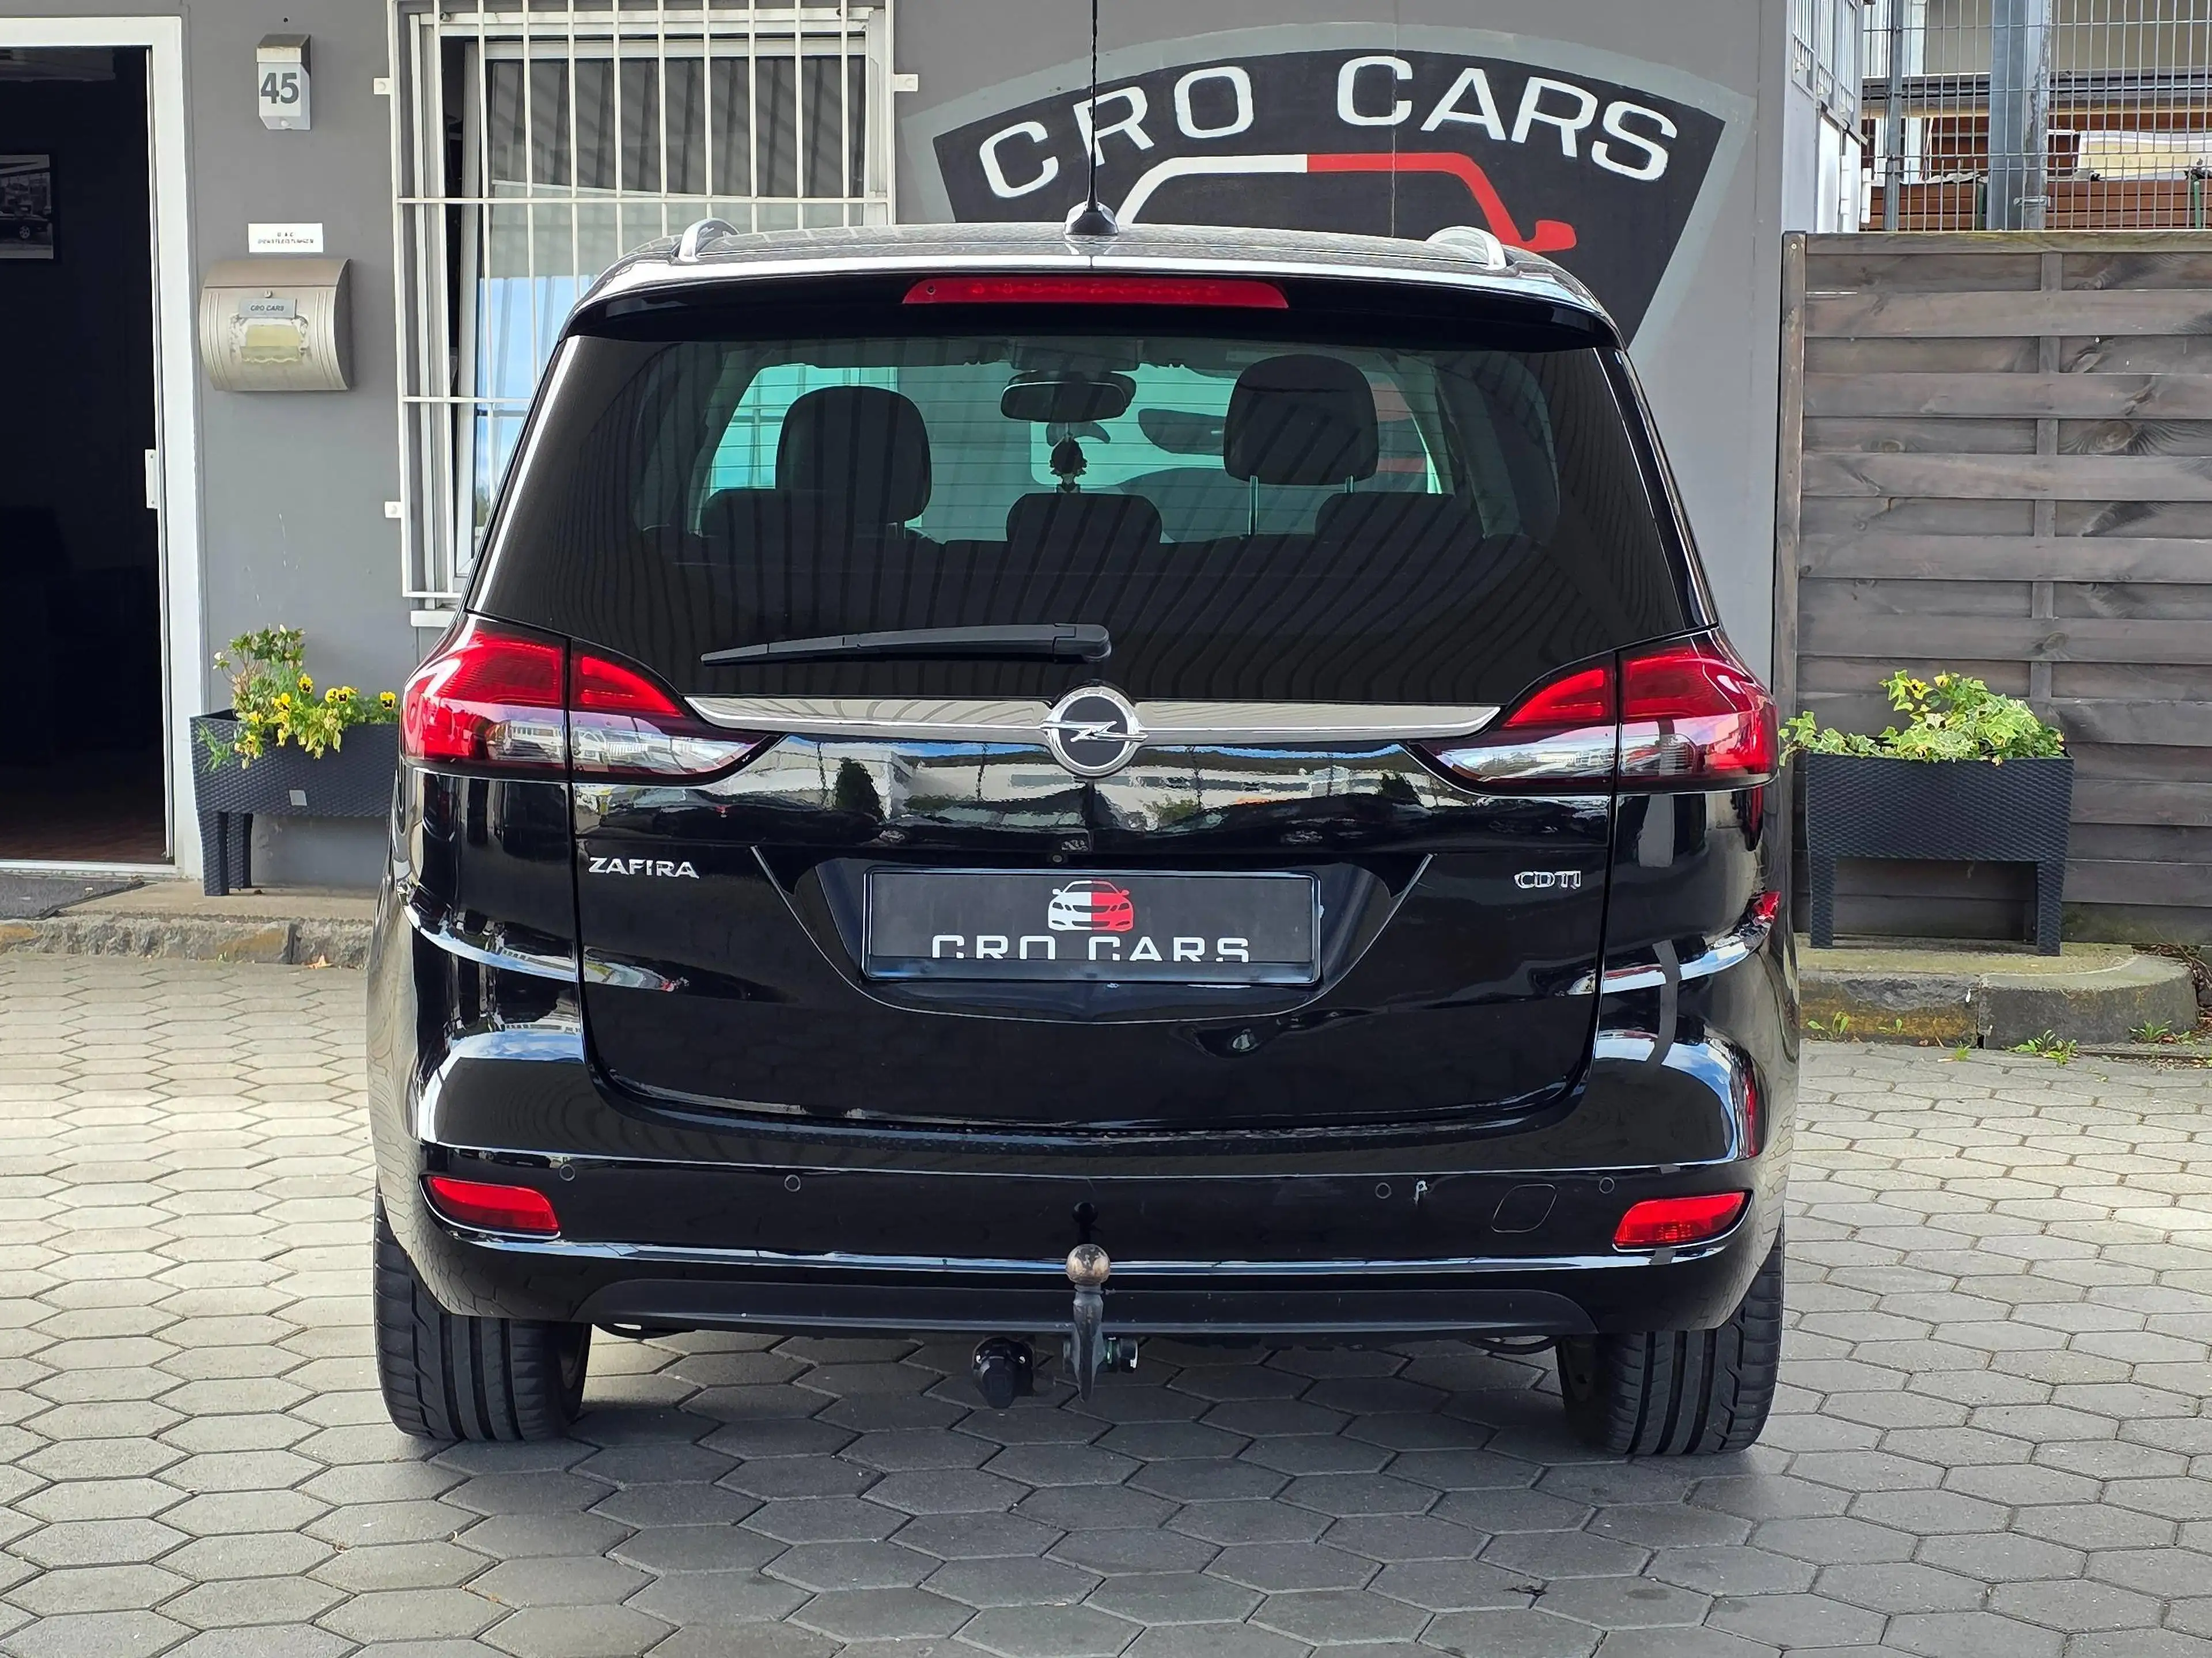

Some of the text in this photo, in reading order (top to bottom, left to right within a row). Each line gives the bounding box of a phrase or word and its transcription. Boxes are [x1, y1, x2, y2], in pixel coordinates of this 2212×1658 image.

[260, 72, 299, 104] 45
[979, 56, 1677, 198] CRO CARS
[588, 857, 700, 879] ZAFIRA
[1514, 870, 1581, 890] CDTI
[1088, 936, 1249, 962] CARS
